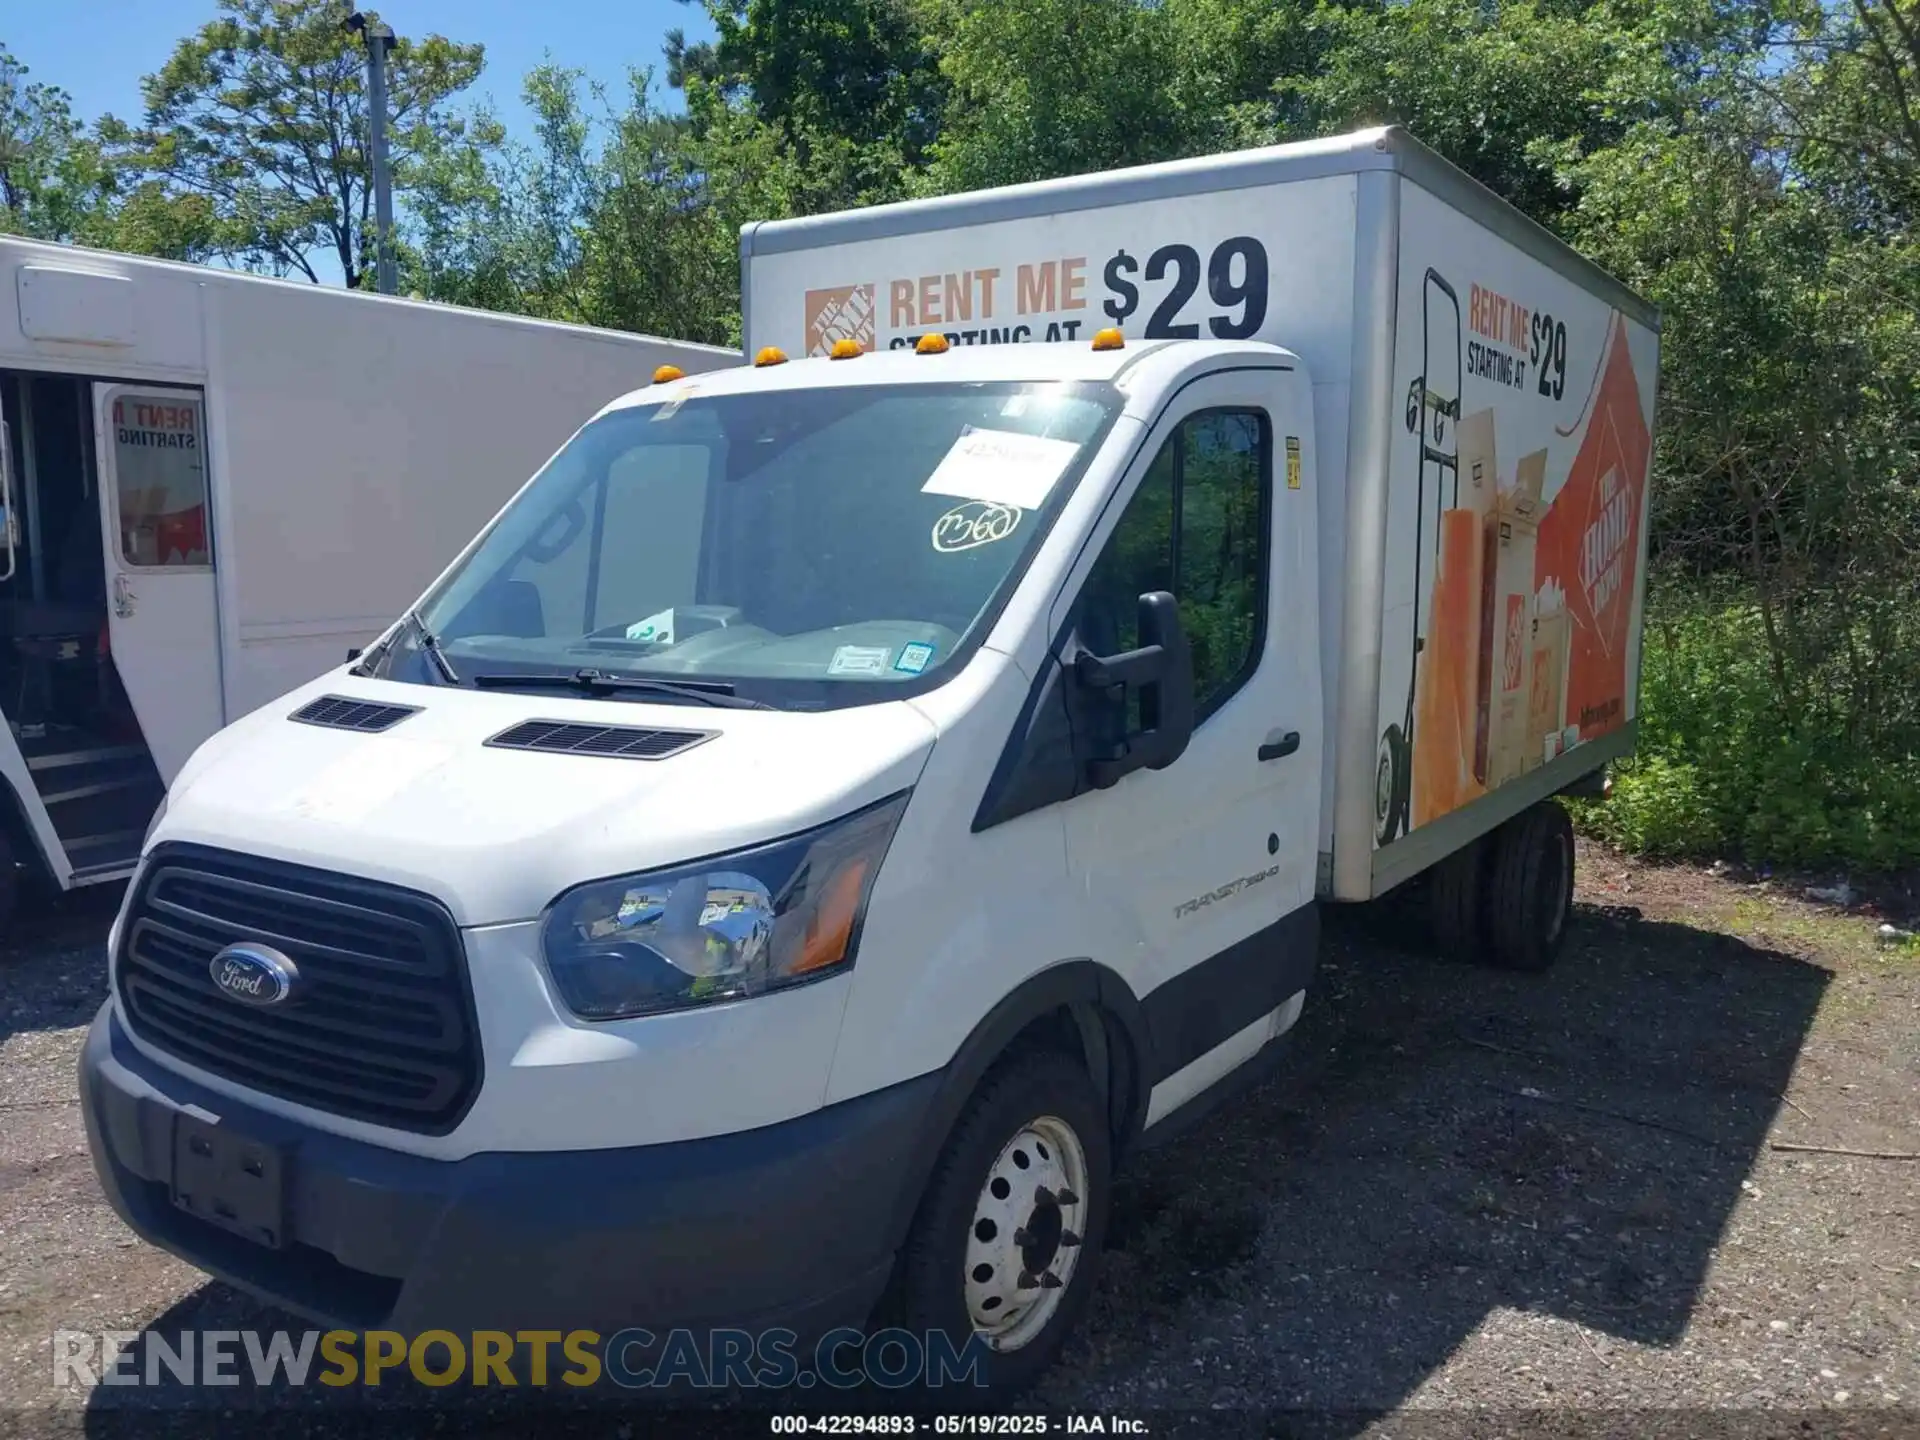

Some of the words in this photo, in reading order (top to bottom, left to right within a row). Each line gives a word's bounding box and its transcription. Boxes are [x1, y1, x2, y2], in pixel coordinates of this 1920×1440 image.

[889, 267, 1000, 328] RENT
[1017, 256, 1087, 316] ME
[1103, 235, 1269, 340] $29
[1467, 340, 1513, 387] STARTING
[1514, 359, 1526, 391] AT
[1470, 281, 1508, 343] RENT
[1509, 301, 1529, 353] ME
[1530, 307, 1567, 401] $29
[220, 959, 263, 995] Ford
